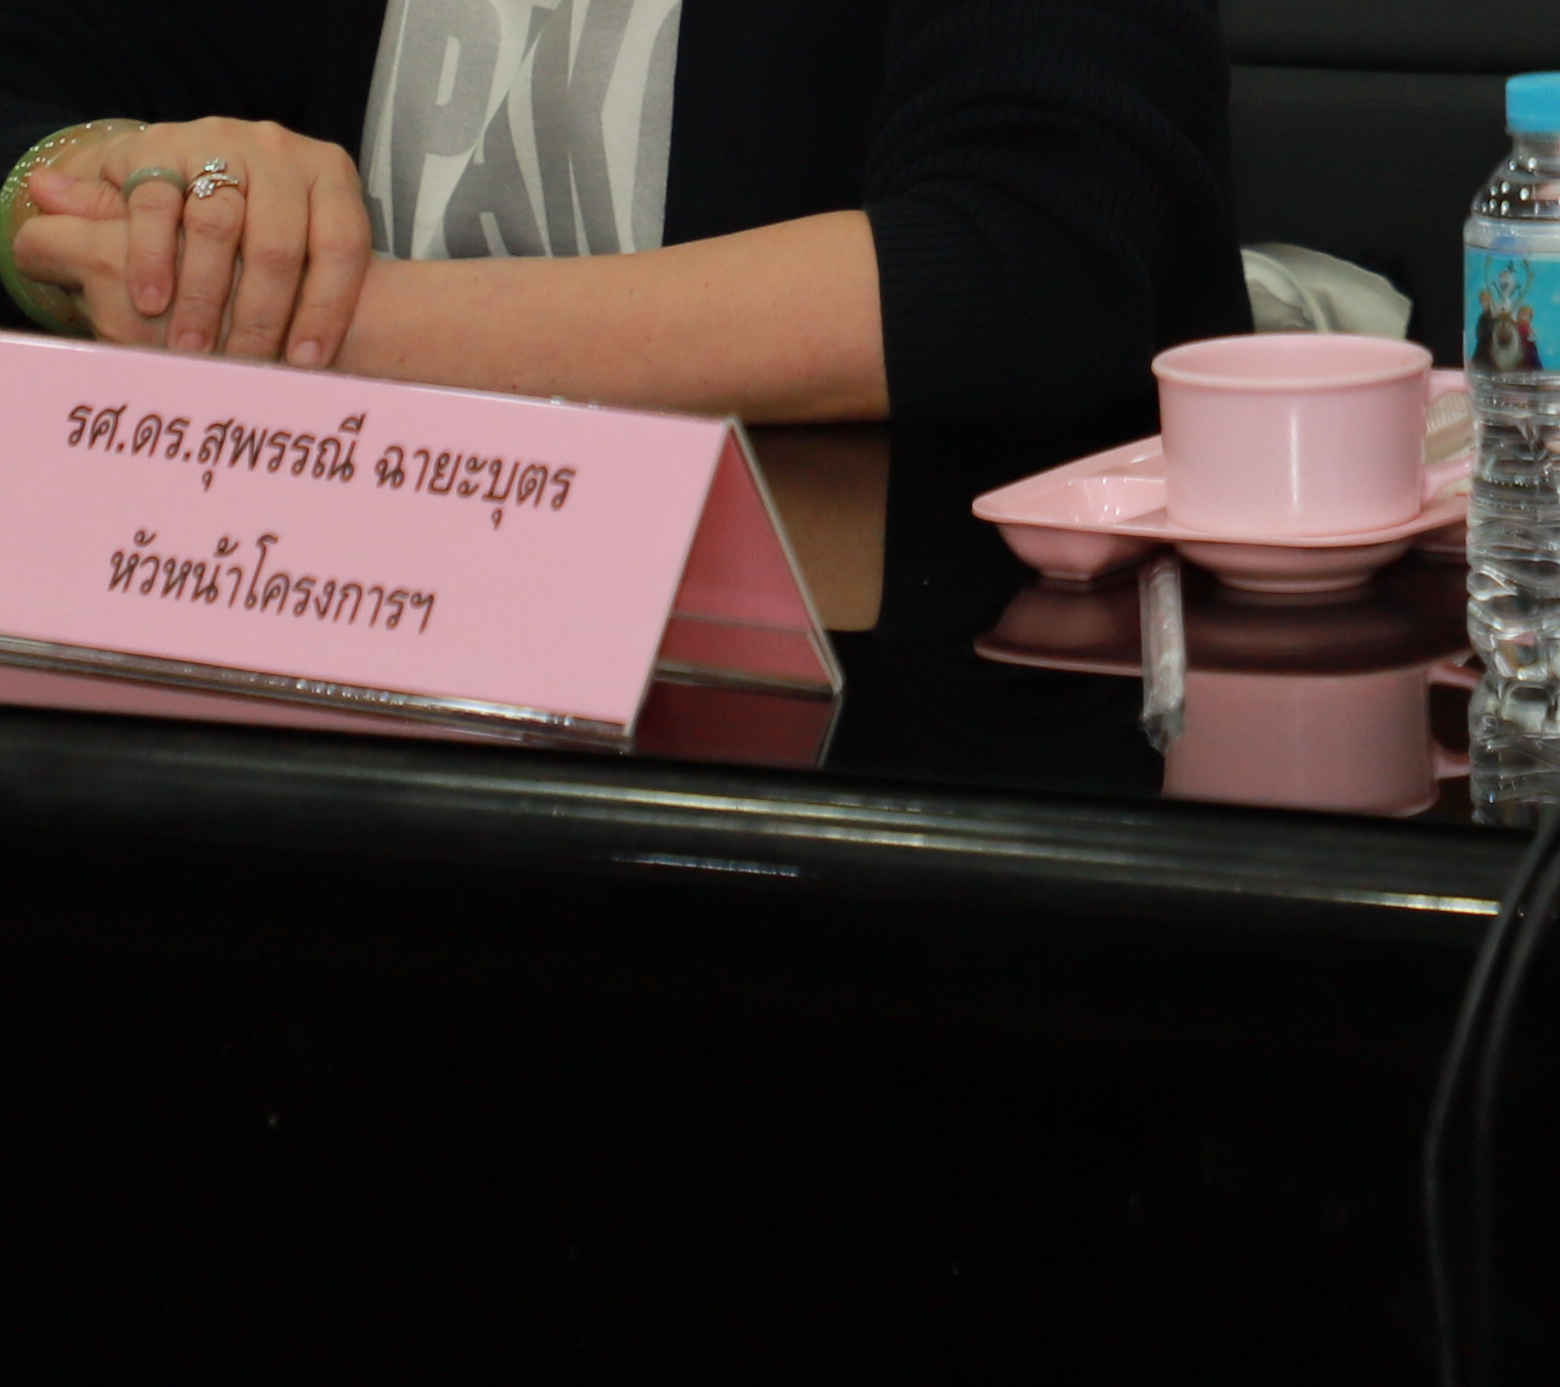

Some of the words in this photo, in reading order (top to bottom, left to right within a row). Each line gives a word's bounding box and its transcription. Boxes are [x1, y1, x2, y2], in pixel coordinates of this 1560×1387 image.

[66, 400, 365, 492] รศ.ดร.สุพรรณี
[374, 440, 577, 530] ฉายะบุตร
[108, 529, 437, 637] หัวหน้าโครงการฯ
